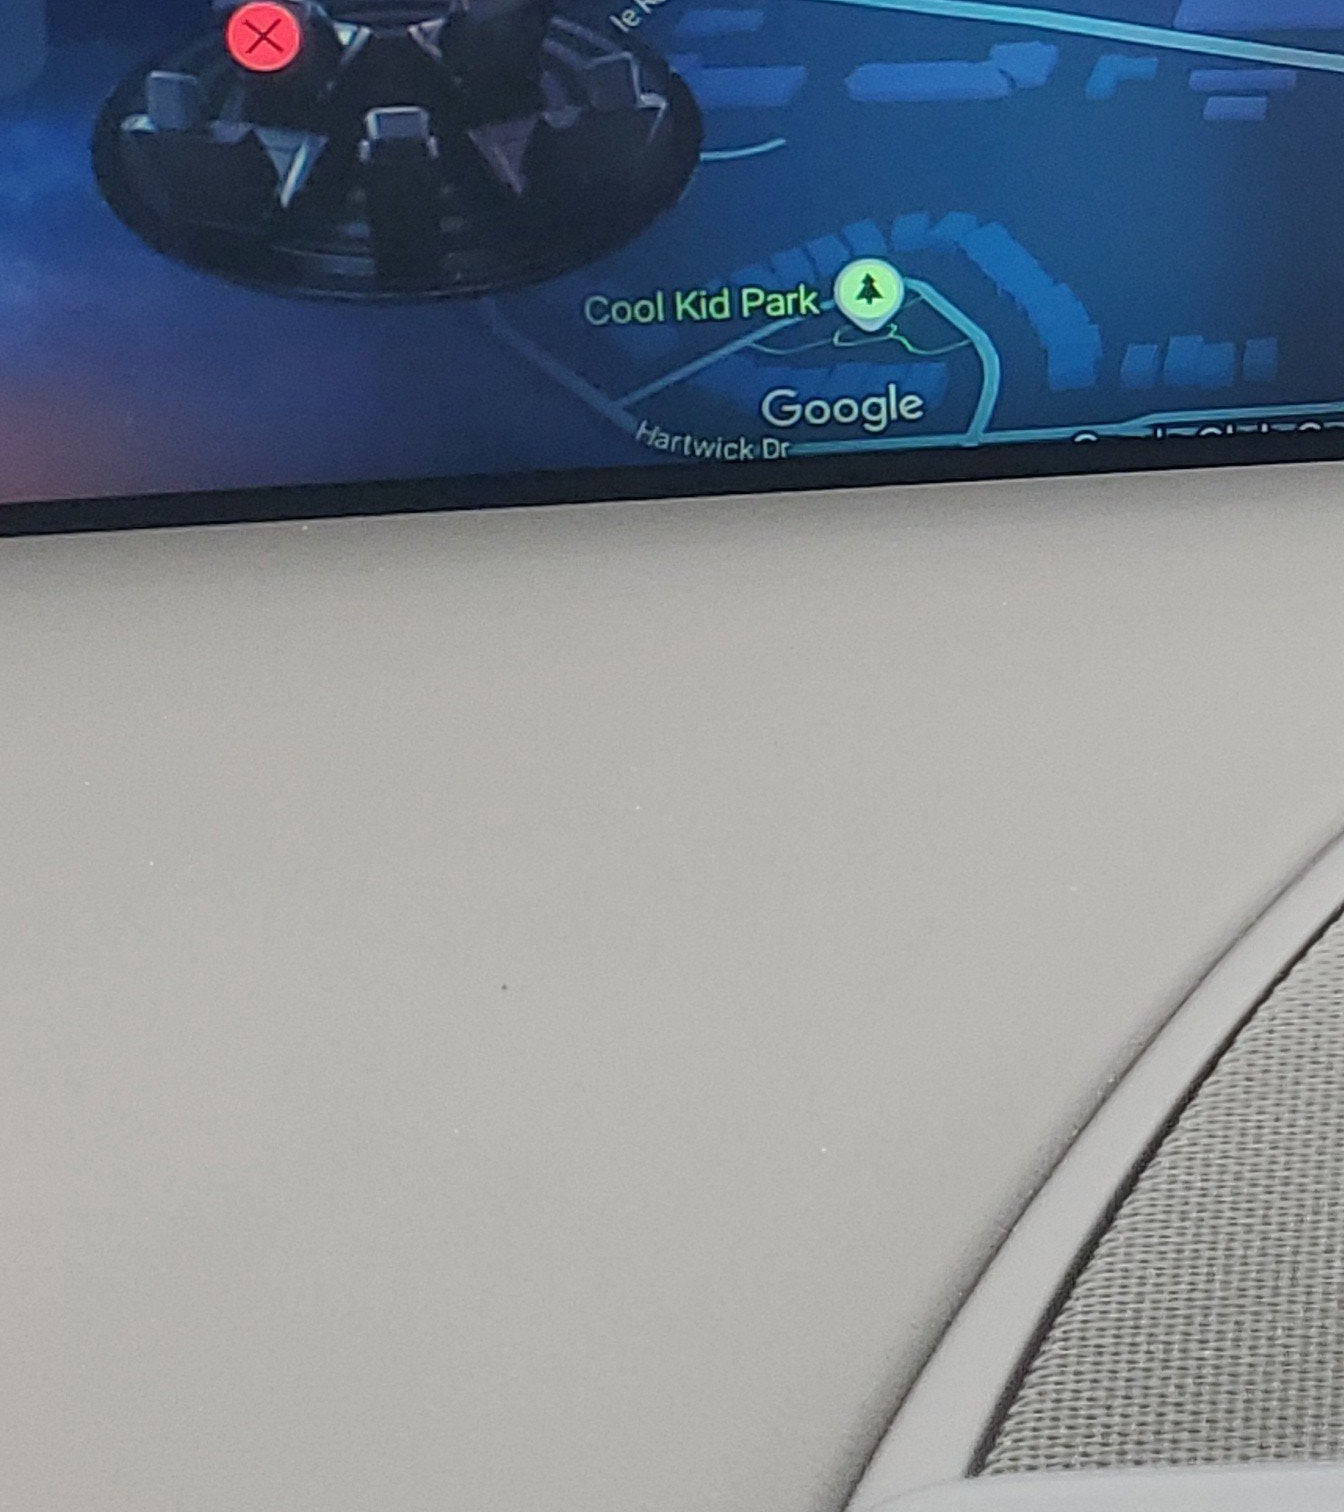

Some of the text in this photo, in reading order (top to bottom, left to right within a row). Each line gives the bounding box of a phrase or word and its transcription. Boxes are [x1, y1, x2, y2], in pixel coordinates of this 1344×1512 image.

[584, 282, 822, 326] Cool Kid Park
[760, 383, 924, 433] Google
[635, 418, 791, 461] Hartwick Dr
